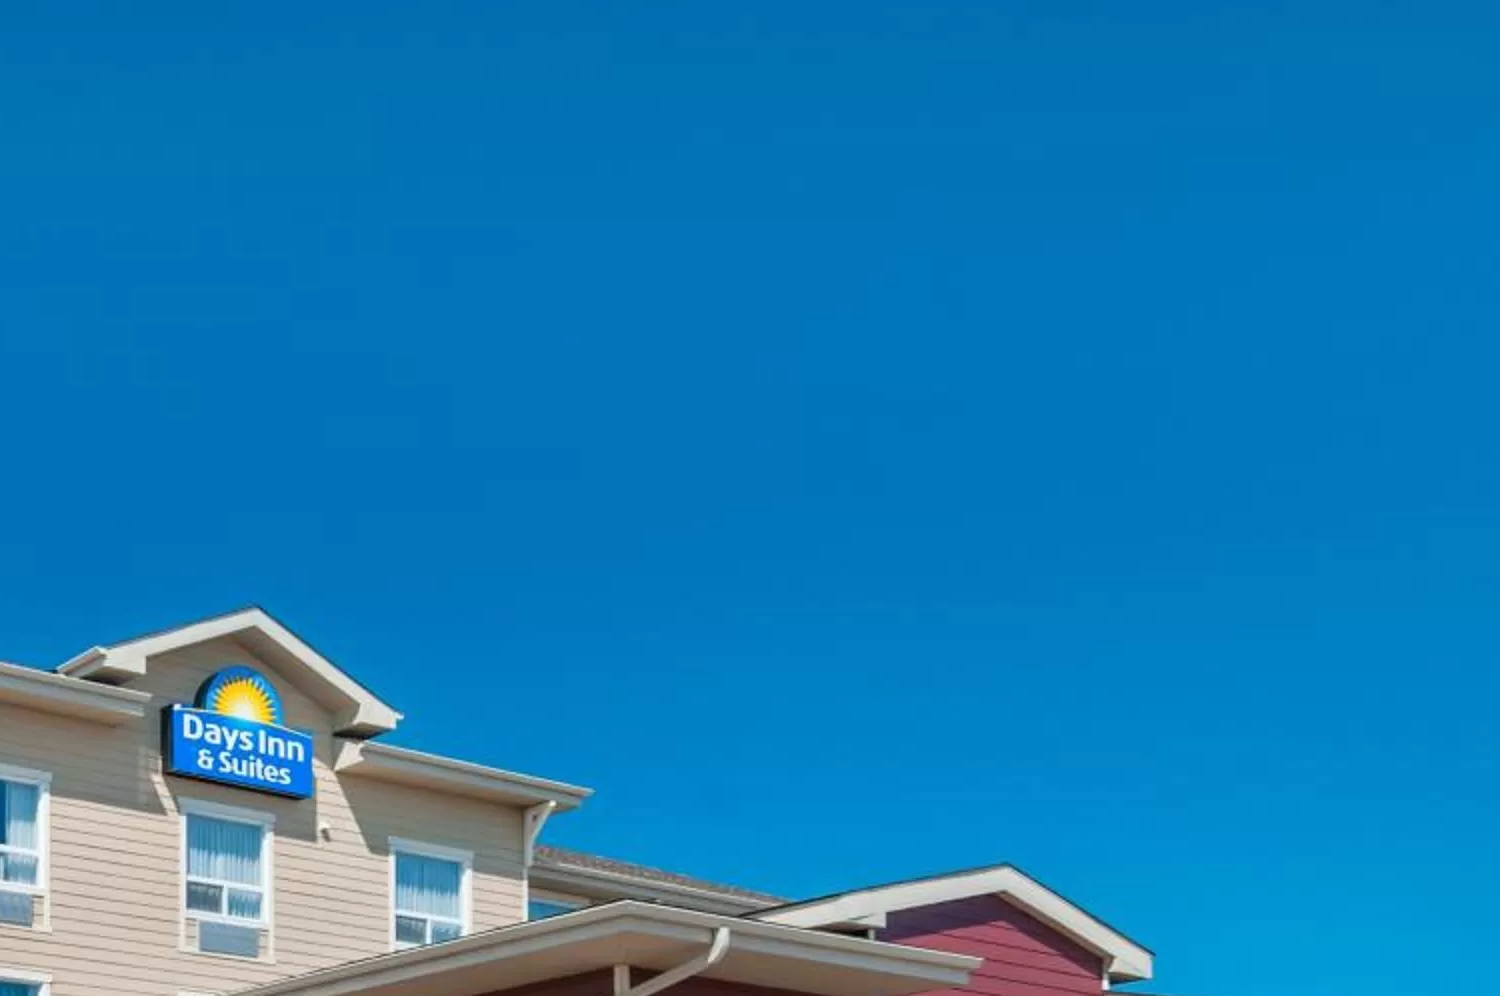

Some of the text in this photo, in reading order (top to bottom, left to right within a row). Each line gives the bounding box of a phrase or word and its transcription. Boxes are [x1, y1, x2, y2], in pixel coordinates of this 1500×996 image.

[182, 713, 305, 762] Days Inn
[197, 748, 292, 785] & Suites
